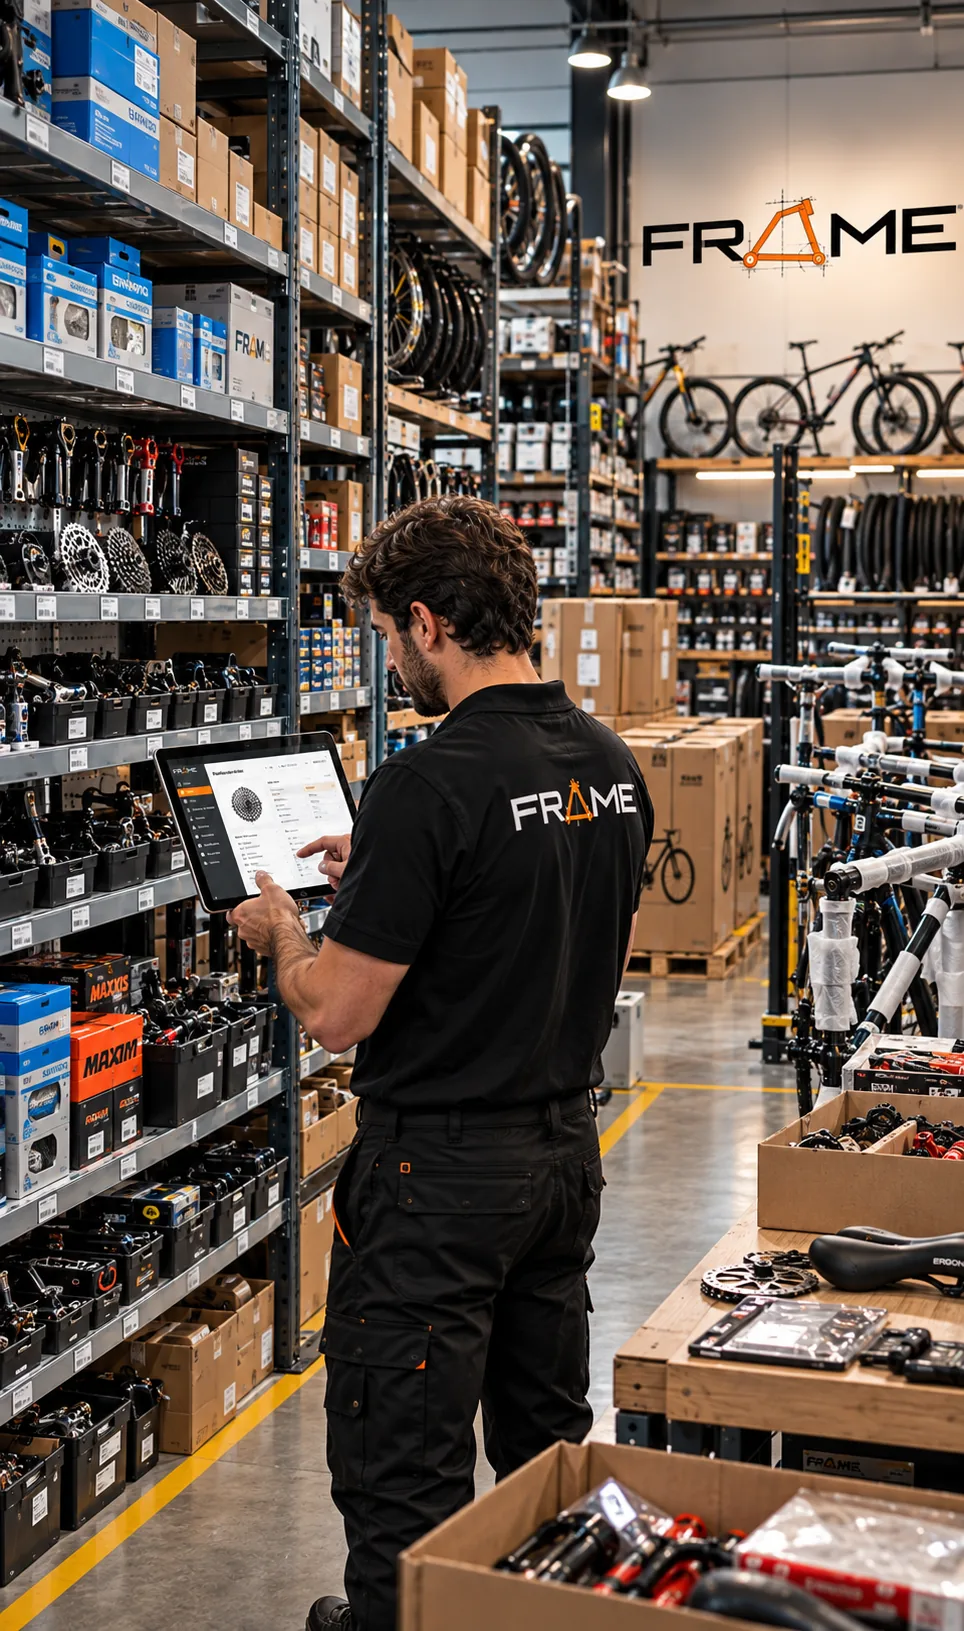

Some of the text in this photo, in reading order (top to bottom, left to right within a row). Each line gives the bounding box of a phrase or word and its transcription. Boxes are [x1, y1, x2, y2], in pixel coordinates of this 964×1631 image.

[642, 198, 957, 267] FRAME
[510, 778, 637, 831] FRAME
[90, 974, 129, 1003] MAXXIS
[806, 1457, 861, 1473] FRAME
